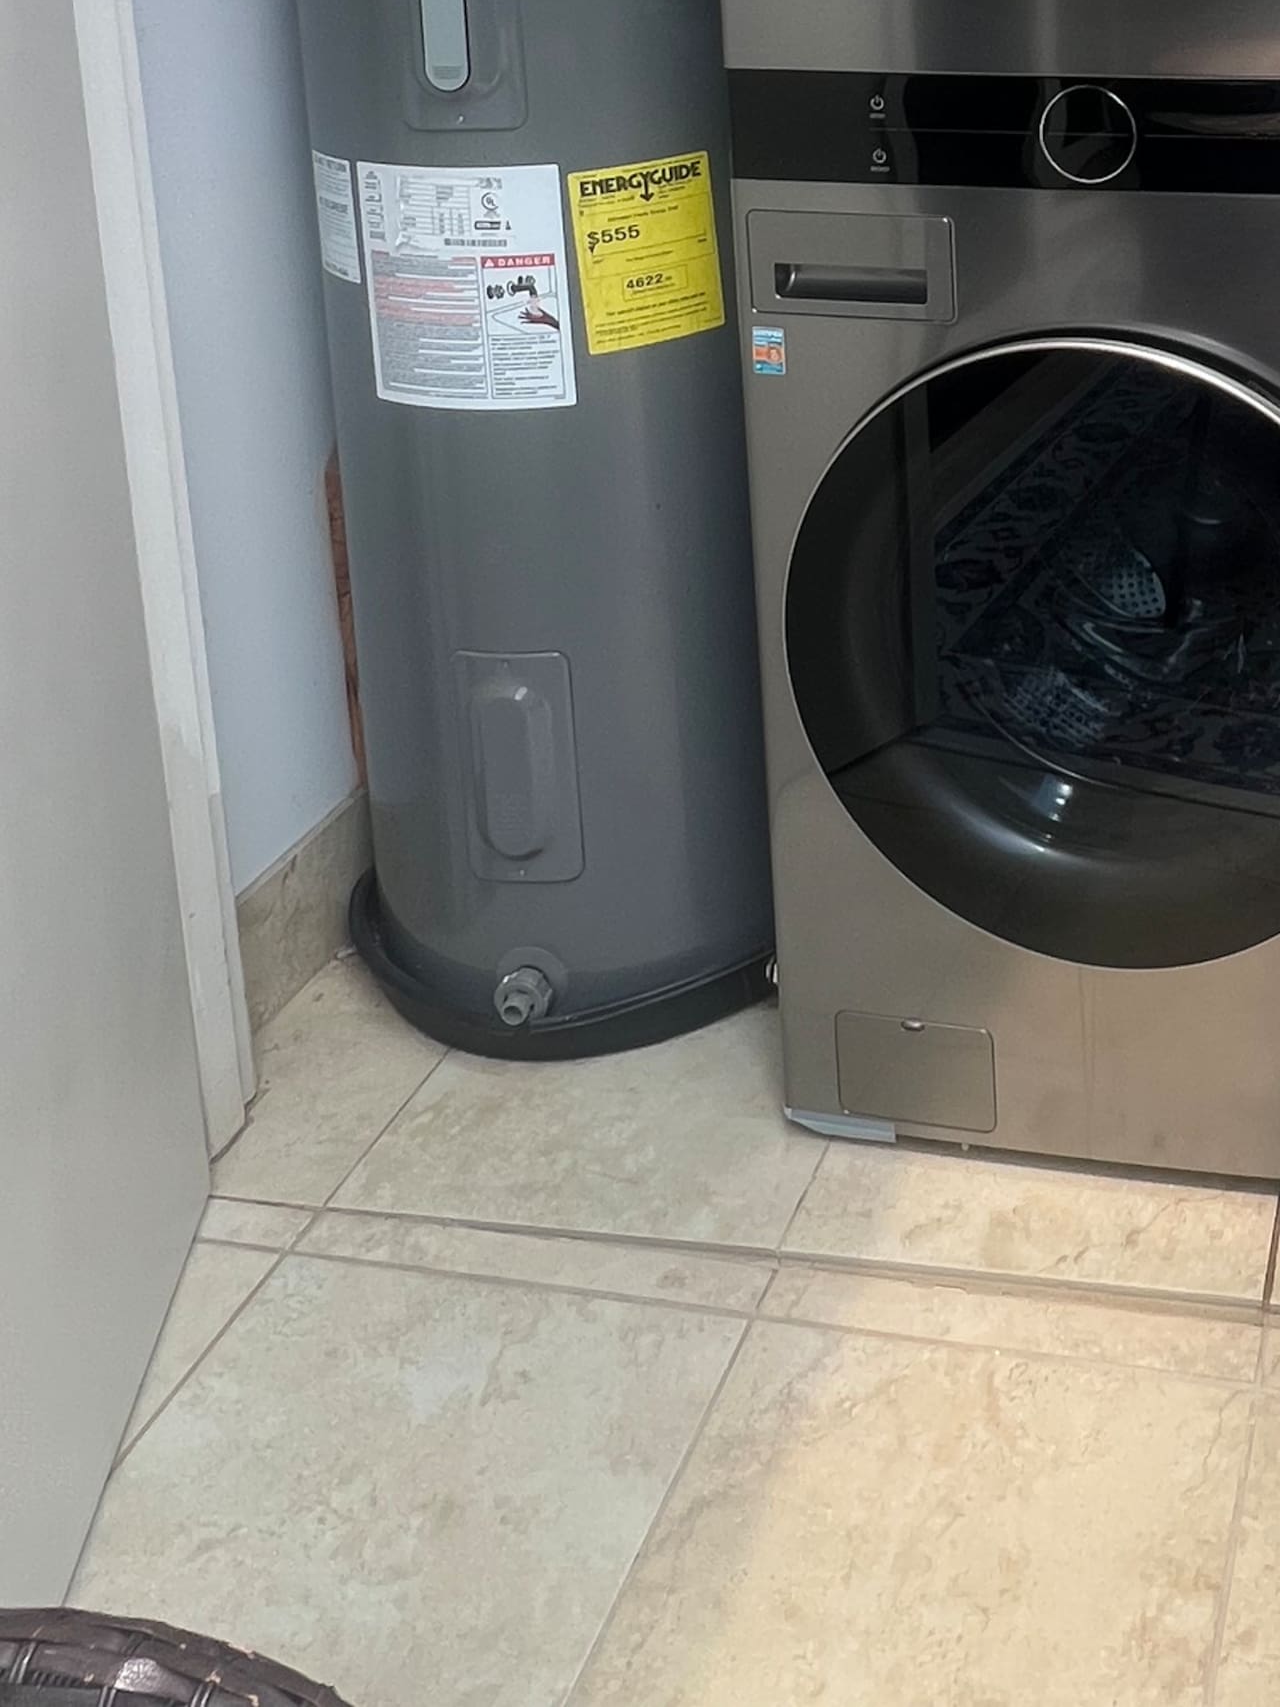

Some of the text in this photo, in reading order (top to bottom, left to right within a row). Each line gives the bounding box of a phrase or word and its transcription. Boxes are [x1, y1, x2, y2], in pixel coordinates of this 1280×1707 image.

[580, 161, 701, 200] ENERGYGUIDE
[587, 225, 640, 246] $555
[498, 256, 551, 267] DANGER
[626, 273, 663, 289] 4622
